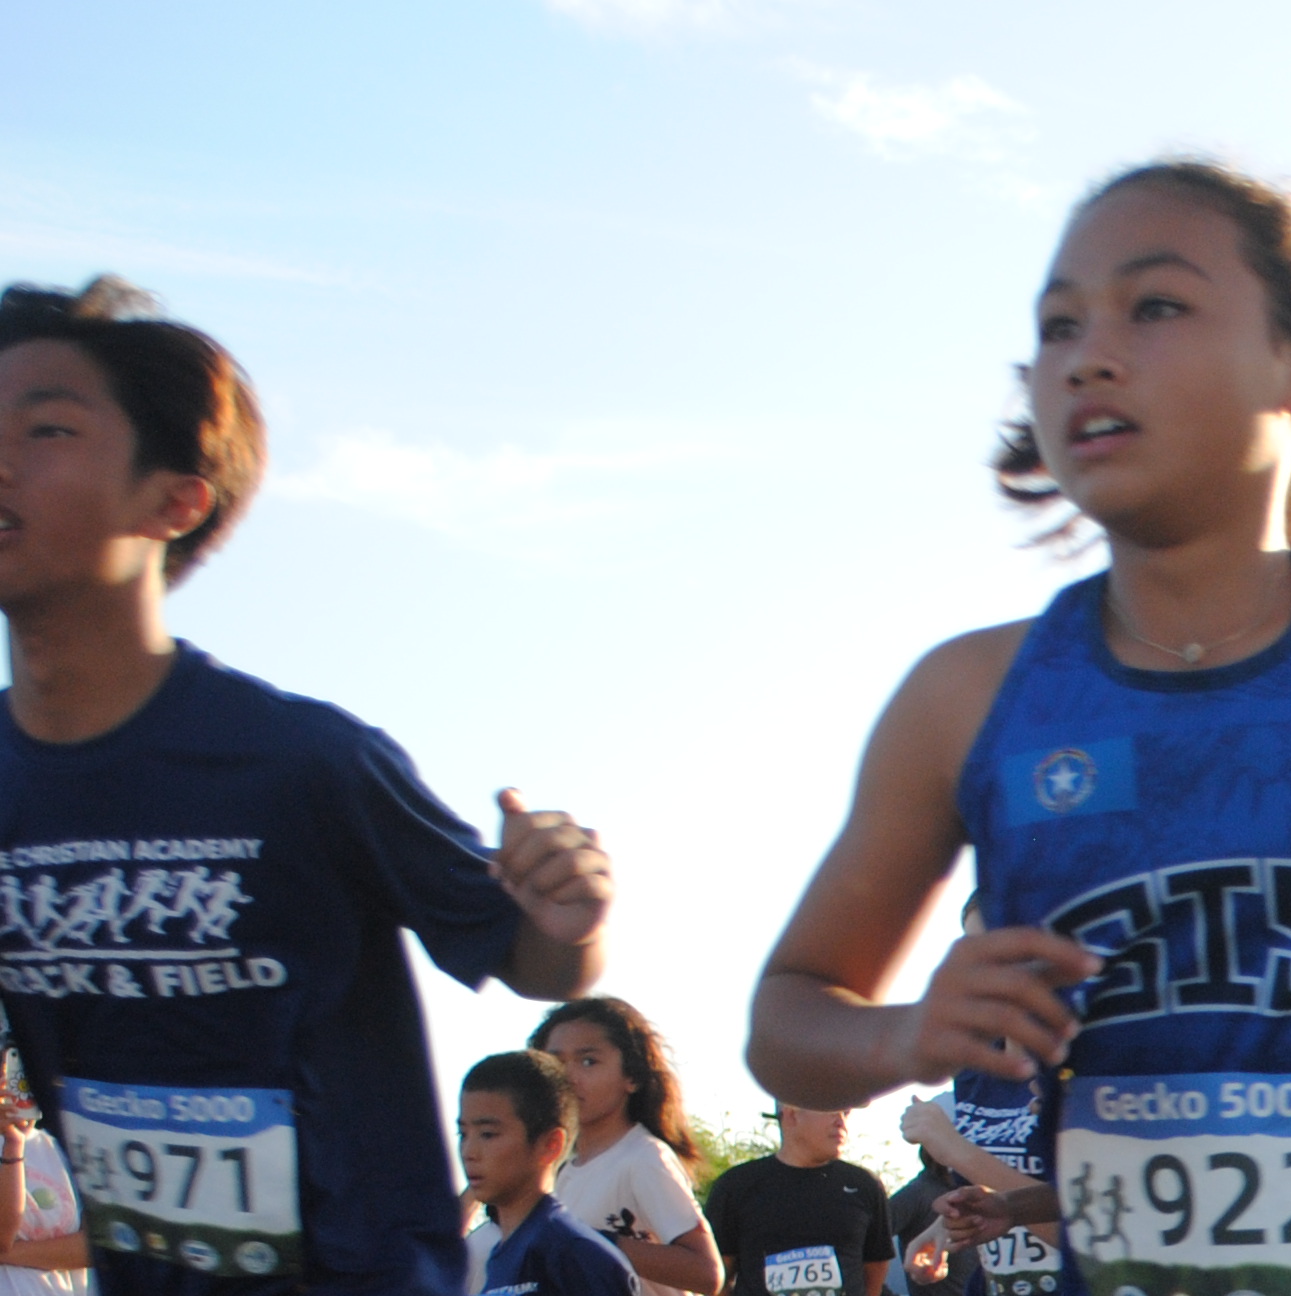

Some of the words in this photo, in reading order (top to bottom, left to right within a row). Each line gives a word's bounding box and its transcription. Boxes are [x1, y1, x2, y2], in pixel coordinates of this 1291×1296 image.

[133, 838, 264, 861] ACADEMY
[106, 963, 148, 998] &
[151, 956, 289, 998] FIELD
[79, 1086, 167, 1120] Gecko
[169, 1094, 256, 1124] 5000
[1096, 1082, 1208, 1122] Gecko
[119, 1139, 256, 1214] 971
[984, 1231, 1047, 1268] 975
[787, 1262, 834, 1285] 765
